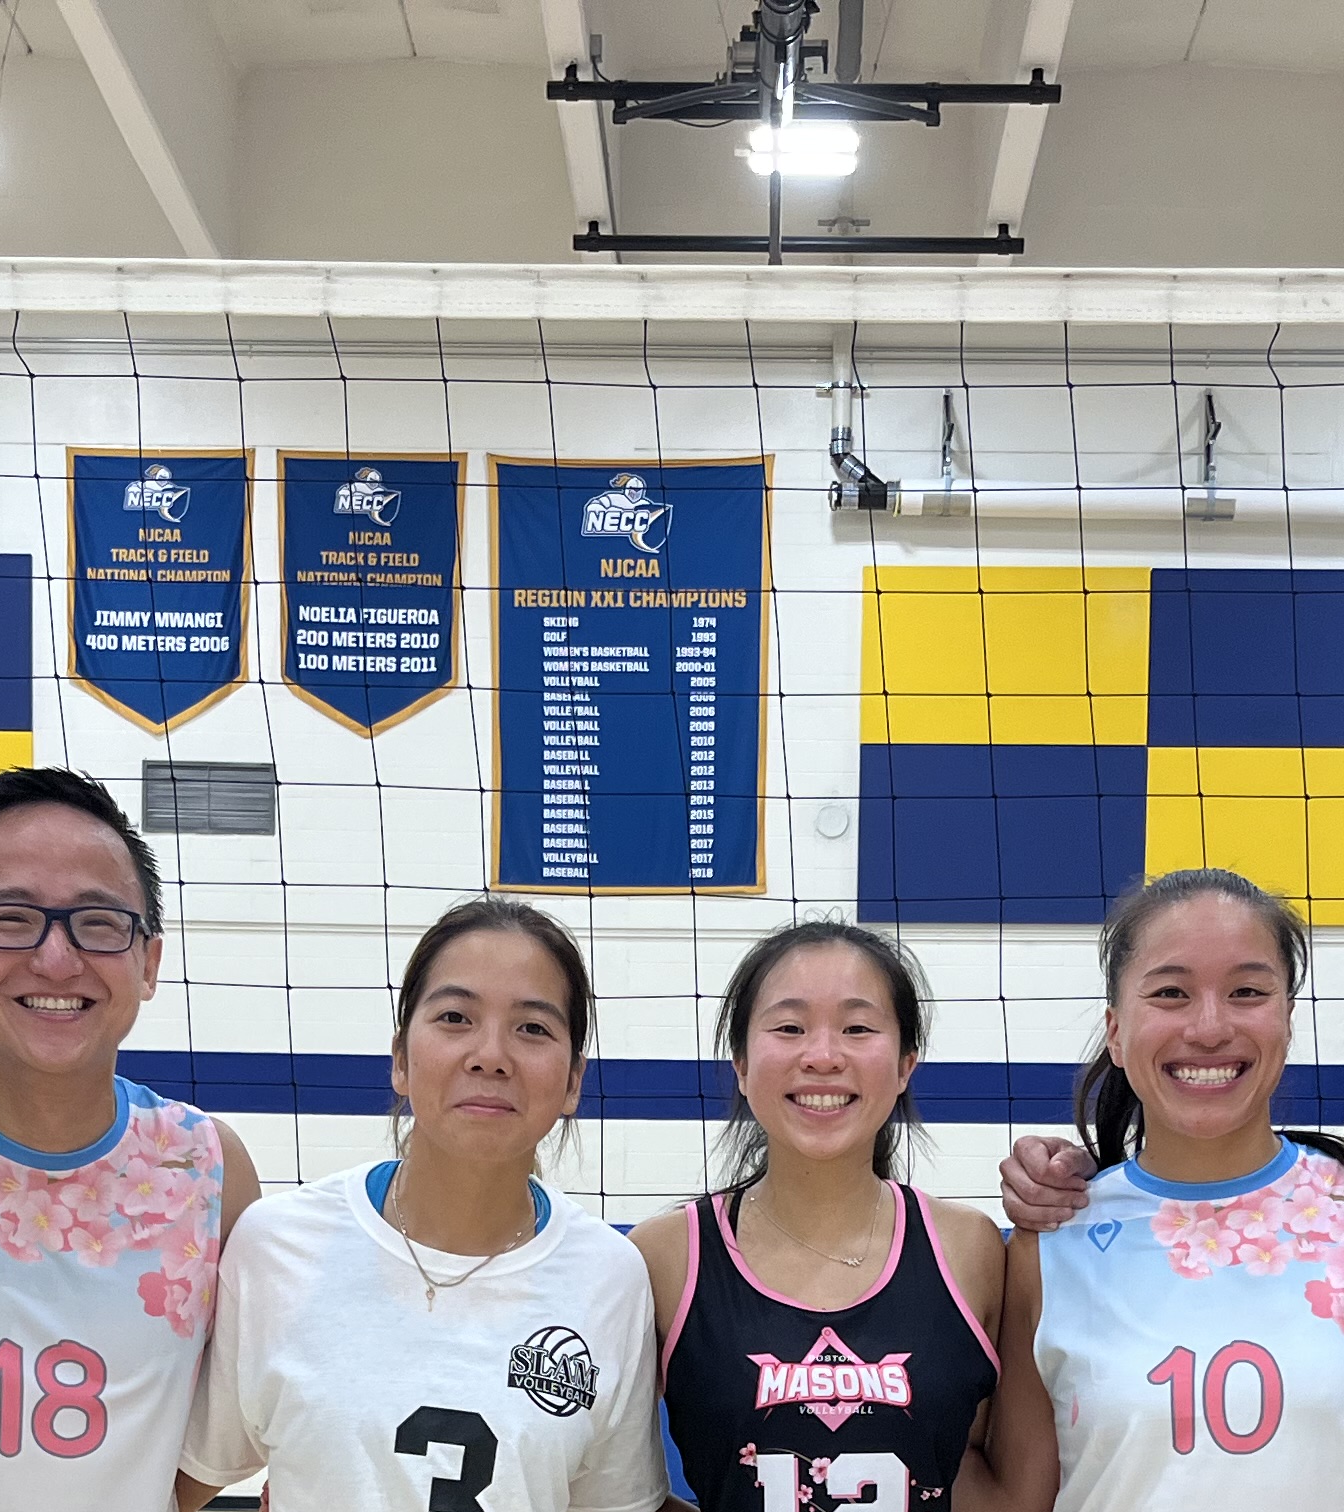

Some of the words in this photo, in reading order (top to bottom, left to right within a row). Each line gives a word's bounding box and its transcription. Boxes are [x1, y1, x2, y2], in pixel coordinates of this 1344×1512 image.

[127, 491, 174, 507] NECC
[338, 495, 385, 511] NECC
[586, 510, 650, 532] NECC
[138, 528, 182, 542] NJCAA
[348, 531, 392, 545] NJCAA
[111, 549, 154, 563] TRACK
[158, 549, 167, 563] &
[171, 549, 209, 563] FIELD
[320, 551, 364, 565] TRACK
[368, 552, 377, 566] &
[381, 552, 419, 567] FIELD
[600, 558, 660, 578] NJCAA
[157, 570, 230, 583] CHAMPION
[367, 573, 442, 587] CHAMPION
[514, 588, 586, 608] REGION
[591, 588, 625, 608] XXI
[629, 588, 747, 608] CHAMPIONS
[94, 610, 151, 628] JIMMY
[154, 611, 224, 628] MWANGI
[299, 605, 356, 623] NOELIA
[359, 608, 440, 625] FIGUEROA
[692, 617, 716, 628] 1974
[86, 634, 118, 650] 400
[122, 634, 186, 652] METERS
[190, 636, 230, 652] 2006
[296, 629, 328, 646] 200
[332, 631, 397, 648] METERS
[400, 632, 440, 649] 2010
[543, 632, 567, 642] GOLF
[691, 632, 716, 643] 1993
[543, 646, 589, 657] WOMEN'S
[591, 646, 650, 657] BASKETBALL
[298, 653, 328, 670] 100
[332, 655, 397, 672] METERS
[400, 656, 437, 673] 2011
[543, 661, 589, 672] WOMEN'S
[591, 661, 650, 672] BASKETBALL
[676, 661, 716, 672] 2000-01
[690, 676, 716, 687] 2005
[543, 735, 600, 746] VOLLEYBALL
[690, 735, 715, 746] 2010
[690, 750, 715, 761] 2012
[690, 765, 715, 776] 2012
[690, 780, 715, 791] 2013
[543, 794, 590, 805] BASEBALL
[543, 808, 590, 819] BASEBALL
[690, 809, 714, 820] 2015
[690, 838, 714, 849] 2017
[543, 852, 599, 864] VOLLEYBALL
[690, 853, 714, 864] 2017
[543, 867, 589, 878] BASEBALL
[510, 1345, 600, 1396] SLAM
[514, 1375, 591, 1408] VOLLEYBALL
[758, 1364, 910, 1405] MASONS
[1146, 1340, 1284, 1455] 10
[799, 1405, 874, 1415] VOLLEYBALL
